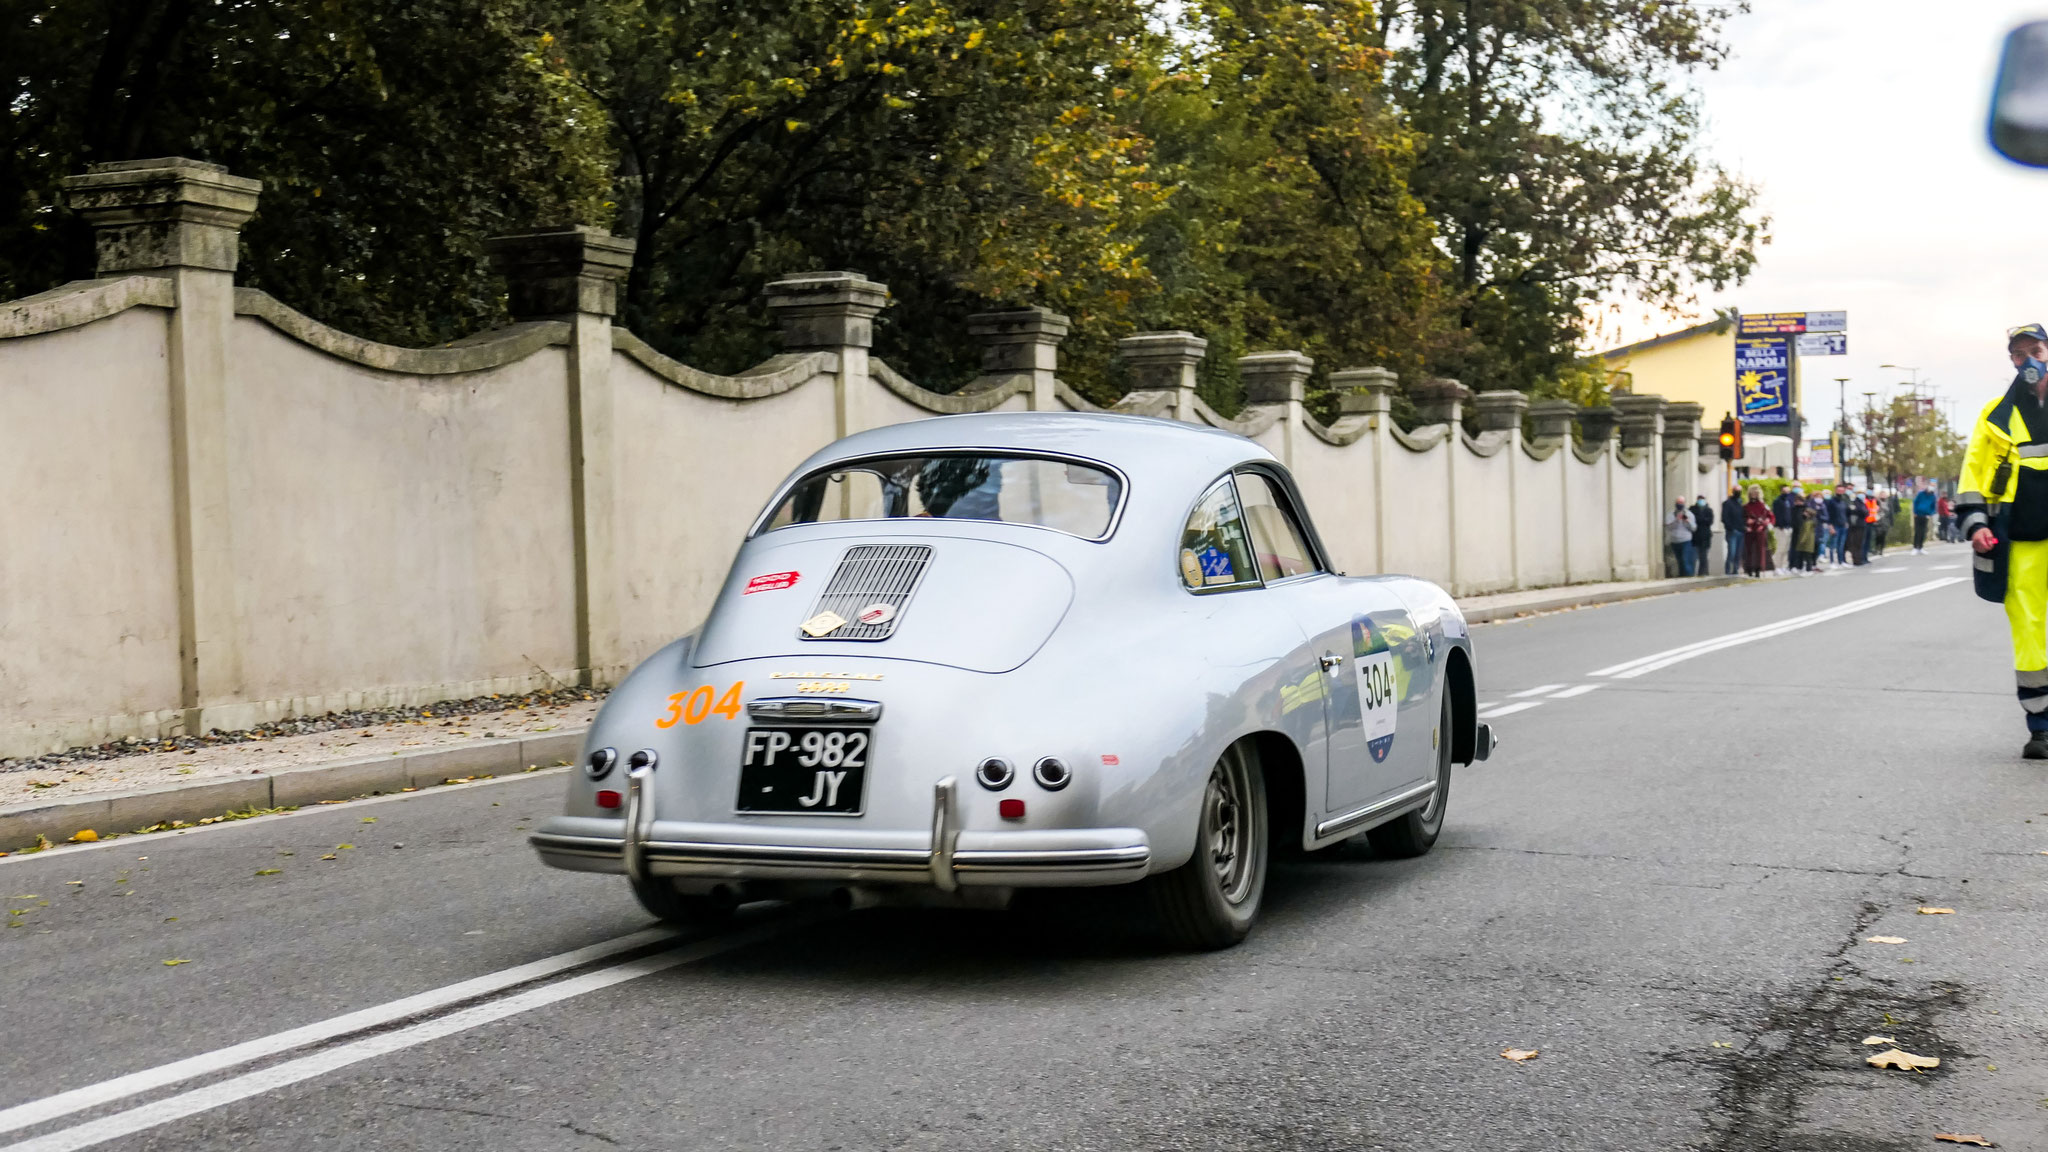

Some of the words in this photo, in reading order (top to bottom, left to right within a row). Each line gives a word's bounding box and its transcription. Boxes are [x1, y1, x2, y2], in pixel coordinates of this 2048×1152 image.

[1736, 357, 1786, 368] NAPOLI
[1744, 349, 1777, 358] BELLA
[752, 573, 791, 584] 1000
[1362, 661, 1393, 711] 304
[655, 680, 746, 729] 304
[744, 731, 868, 768] FP-982
[798, 771, 848, 807] JY
